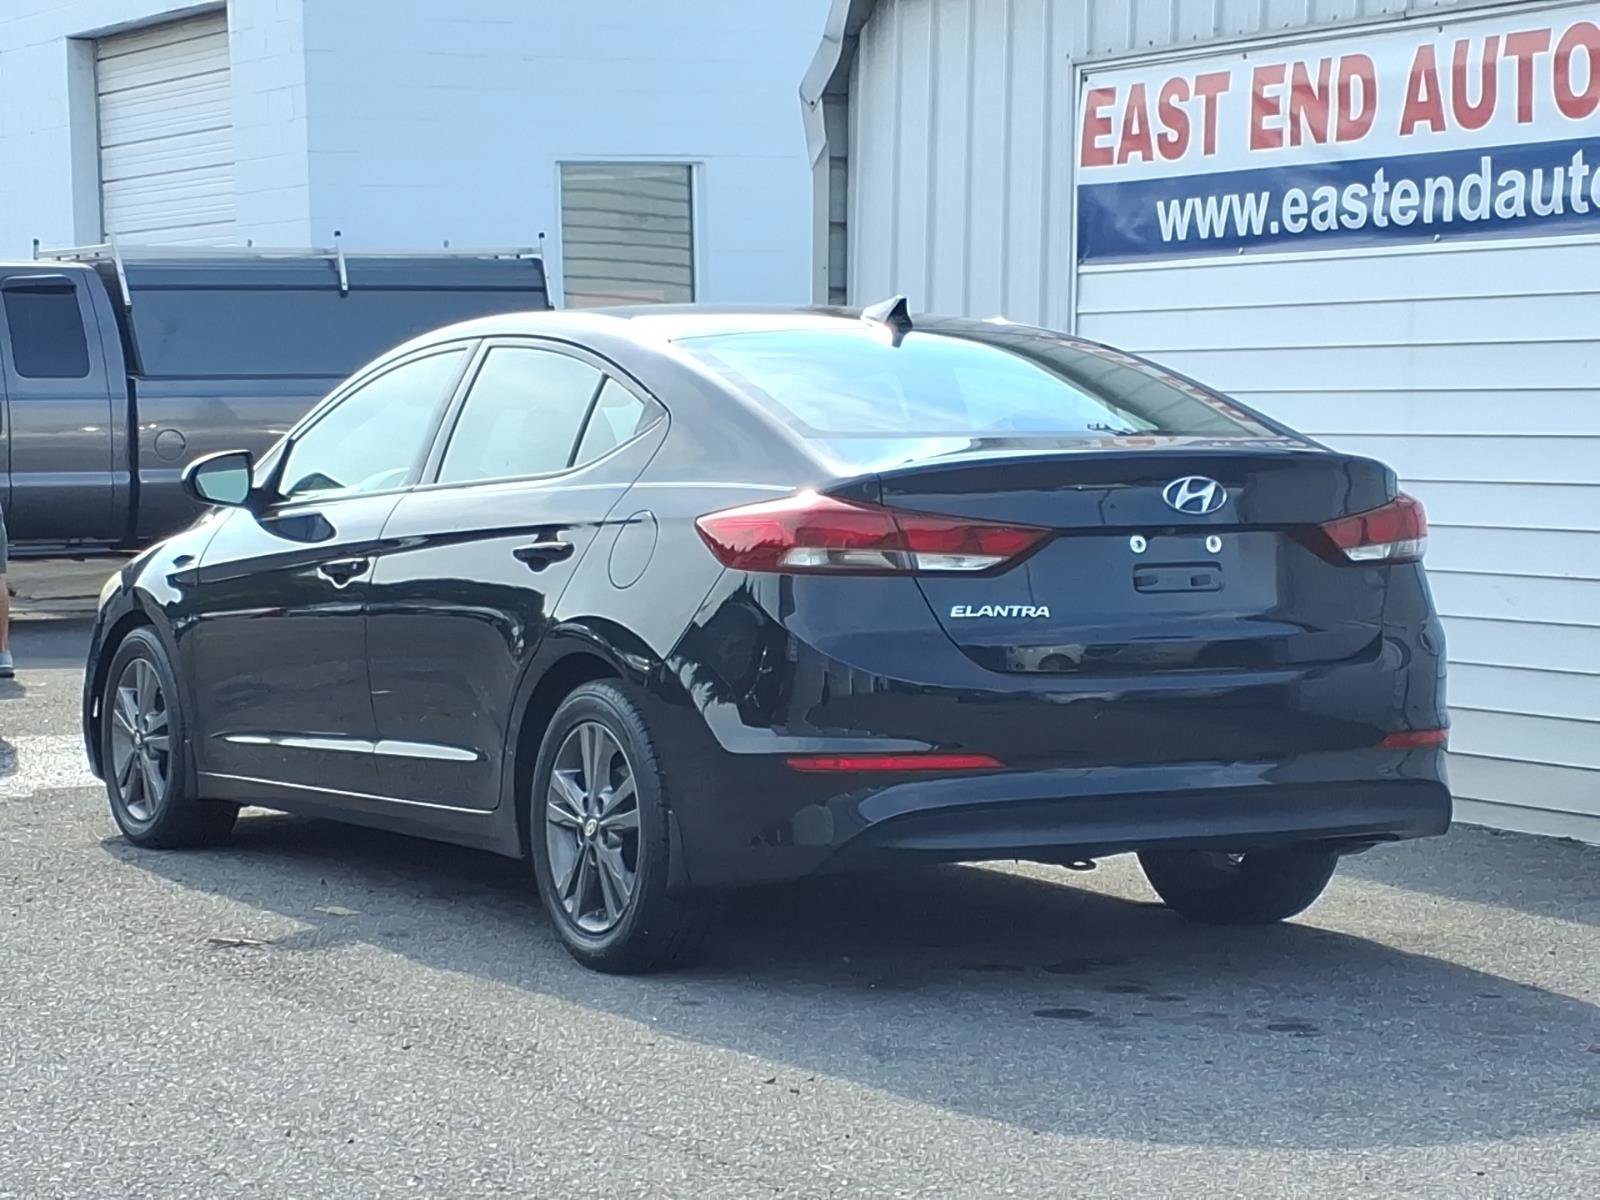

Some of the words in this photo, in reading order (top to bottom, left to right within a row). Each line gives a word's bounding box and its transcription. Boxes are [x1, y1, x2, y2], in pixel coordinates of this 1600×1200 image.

[1080, 71, 1231, 168] EAST
[1249, 53, 1377, 151] END
[1400, 21, 1600, 136] AUTO
[950, 605, 1050, 618] ELANTRA
